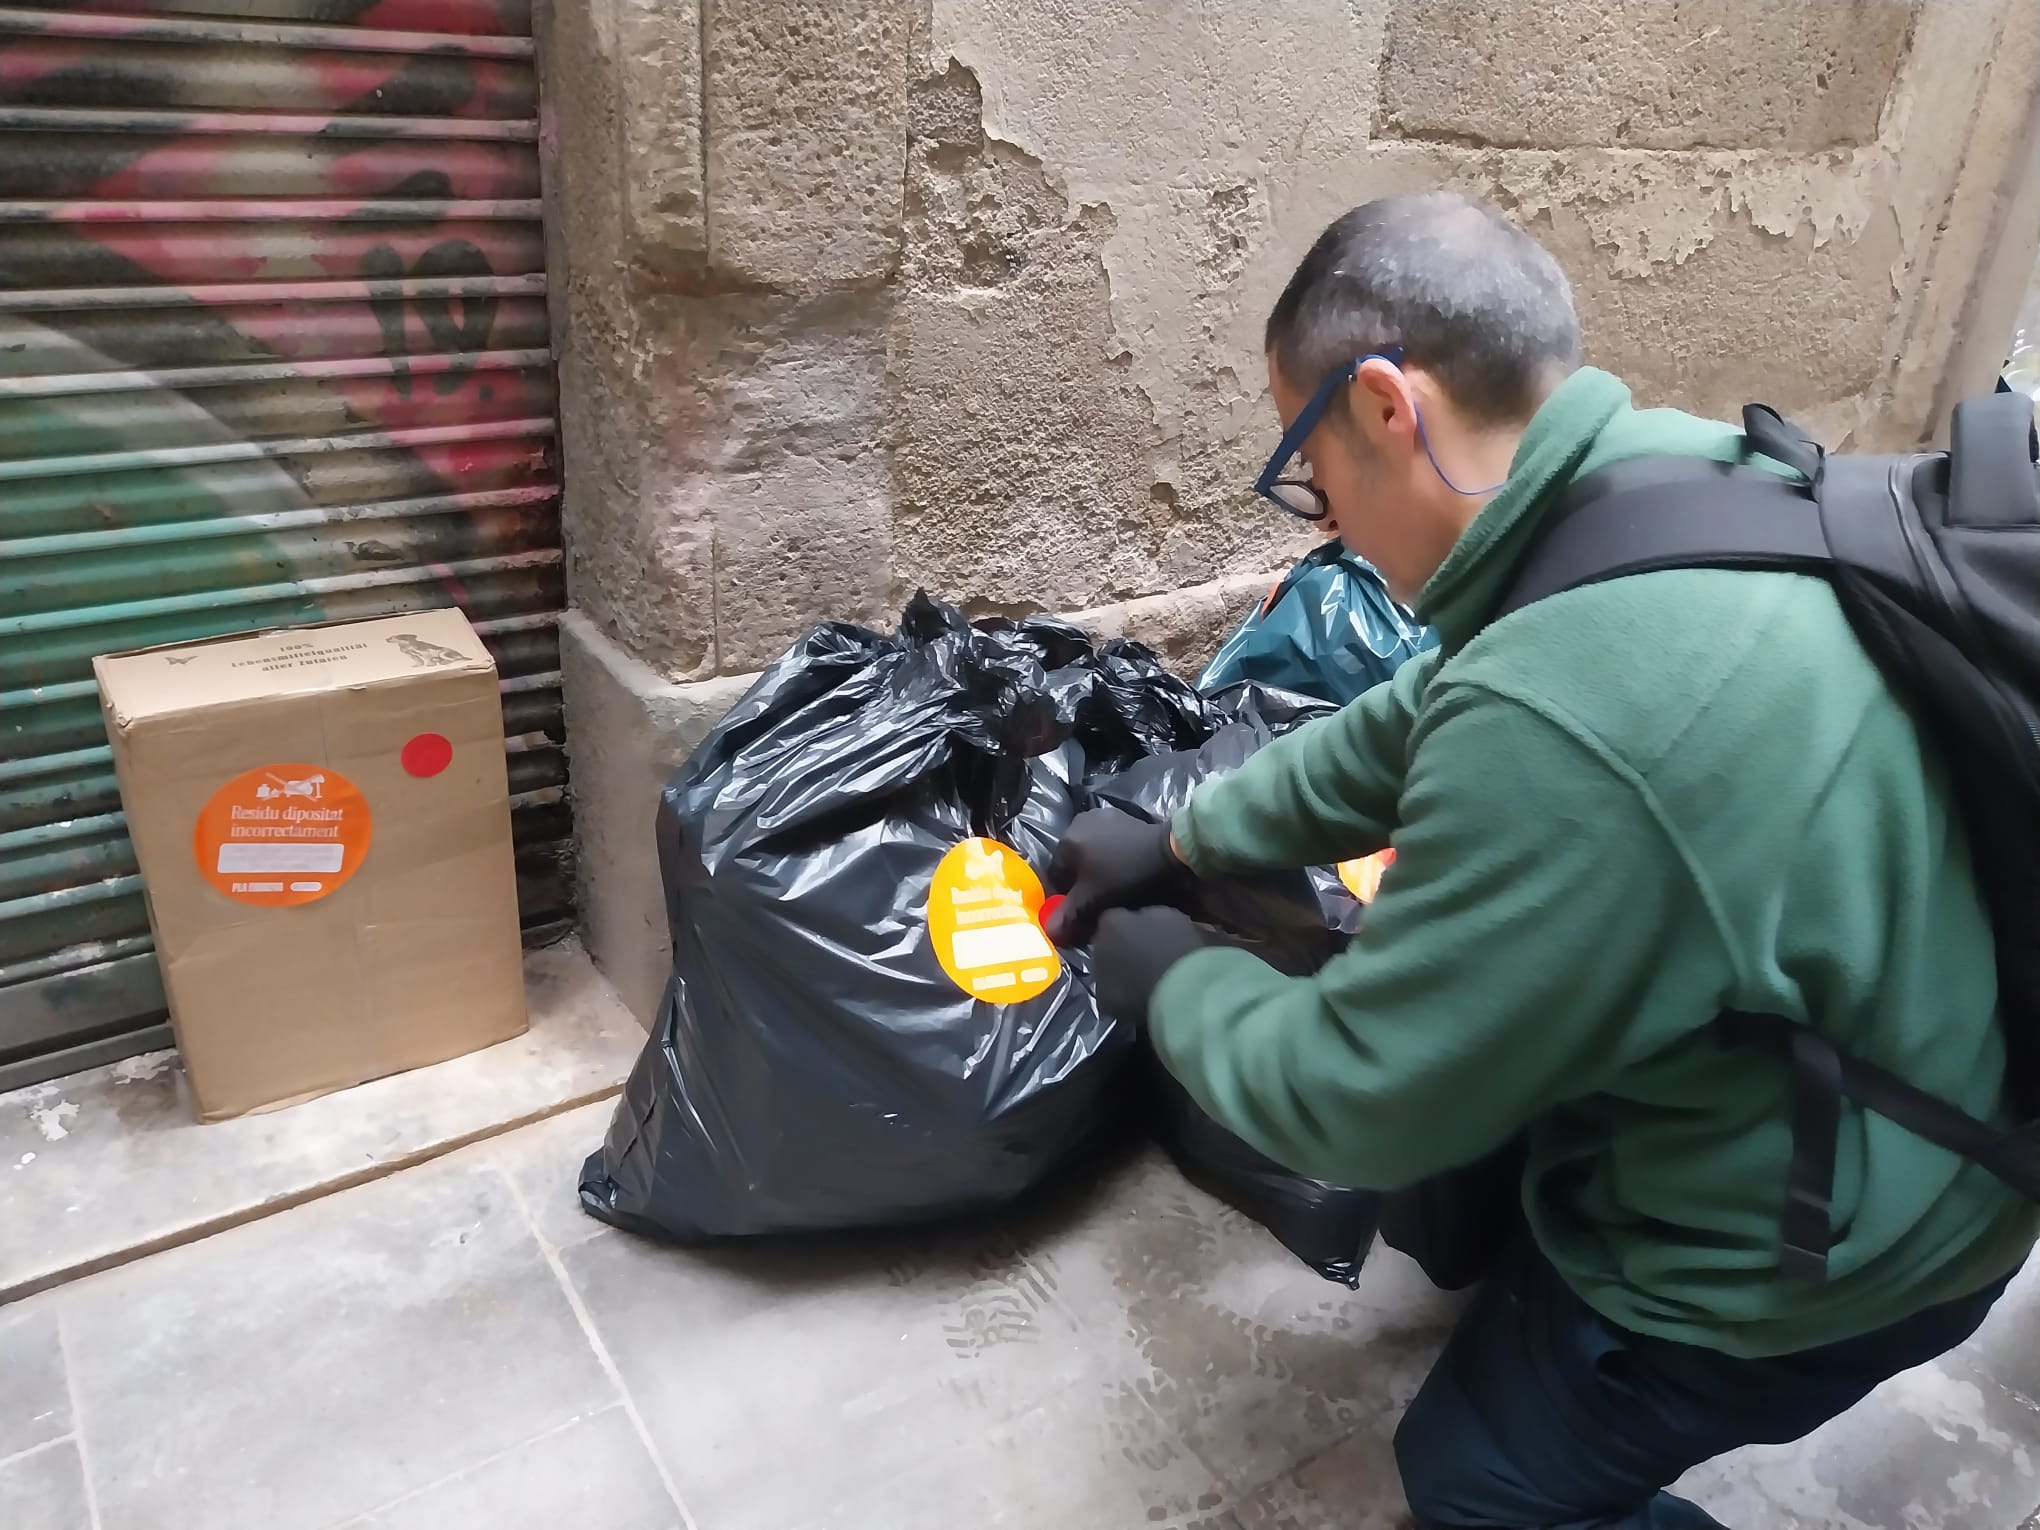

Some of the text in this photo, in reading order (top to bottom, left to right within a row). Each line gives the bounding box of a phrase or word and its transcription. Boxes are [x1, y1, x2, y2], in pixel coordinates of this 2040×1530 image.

[231, 804, 344, 824] Residu dipositat
[230, 824, 340, 838] incorrectament
